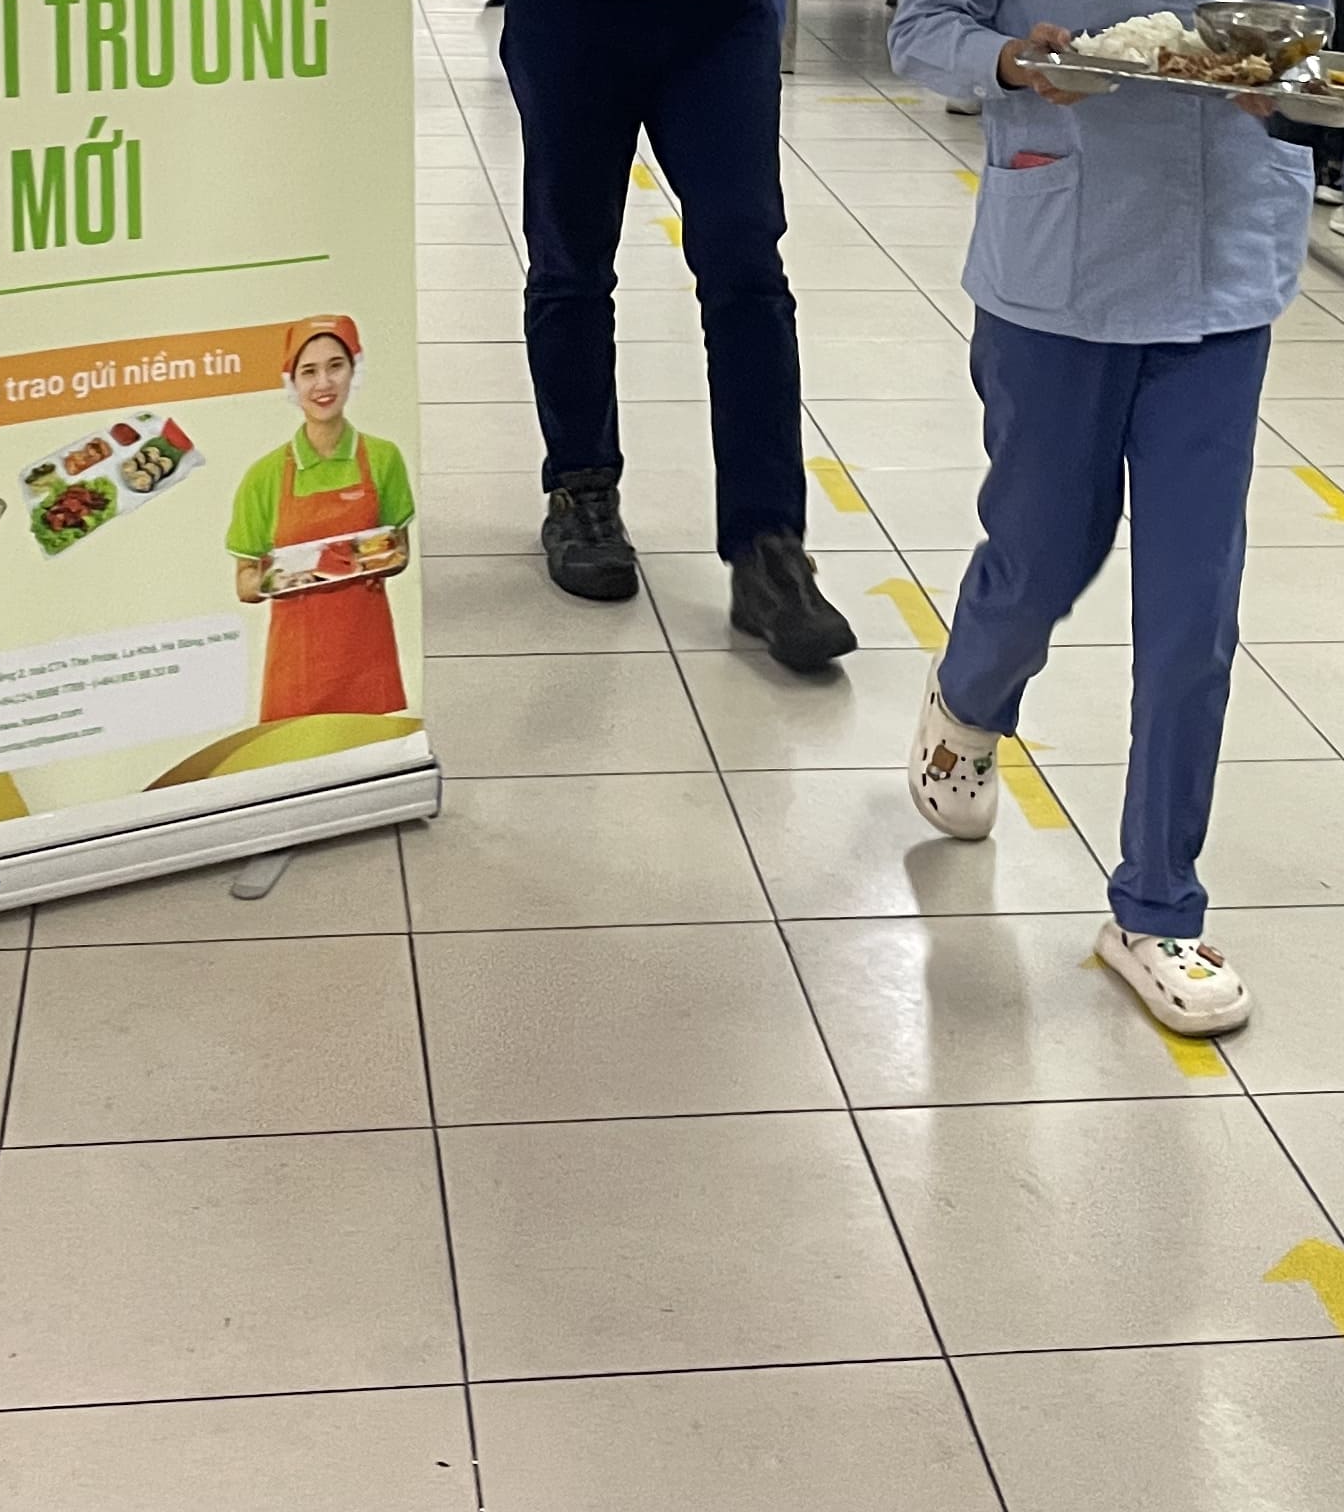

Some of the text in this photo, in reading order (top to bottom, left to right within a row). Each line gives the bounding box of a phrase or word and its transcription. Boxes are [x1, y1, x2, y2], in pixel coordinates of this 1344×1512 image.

[11, 116, 143, 252] MỚI
[6, 375, 65, 403] trao
[72, 360, 116, 399] gửi
[123, 350, 196, 386] niềm
[202, 349, 241, 376] tin
